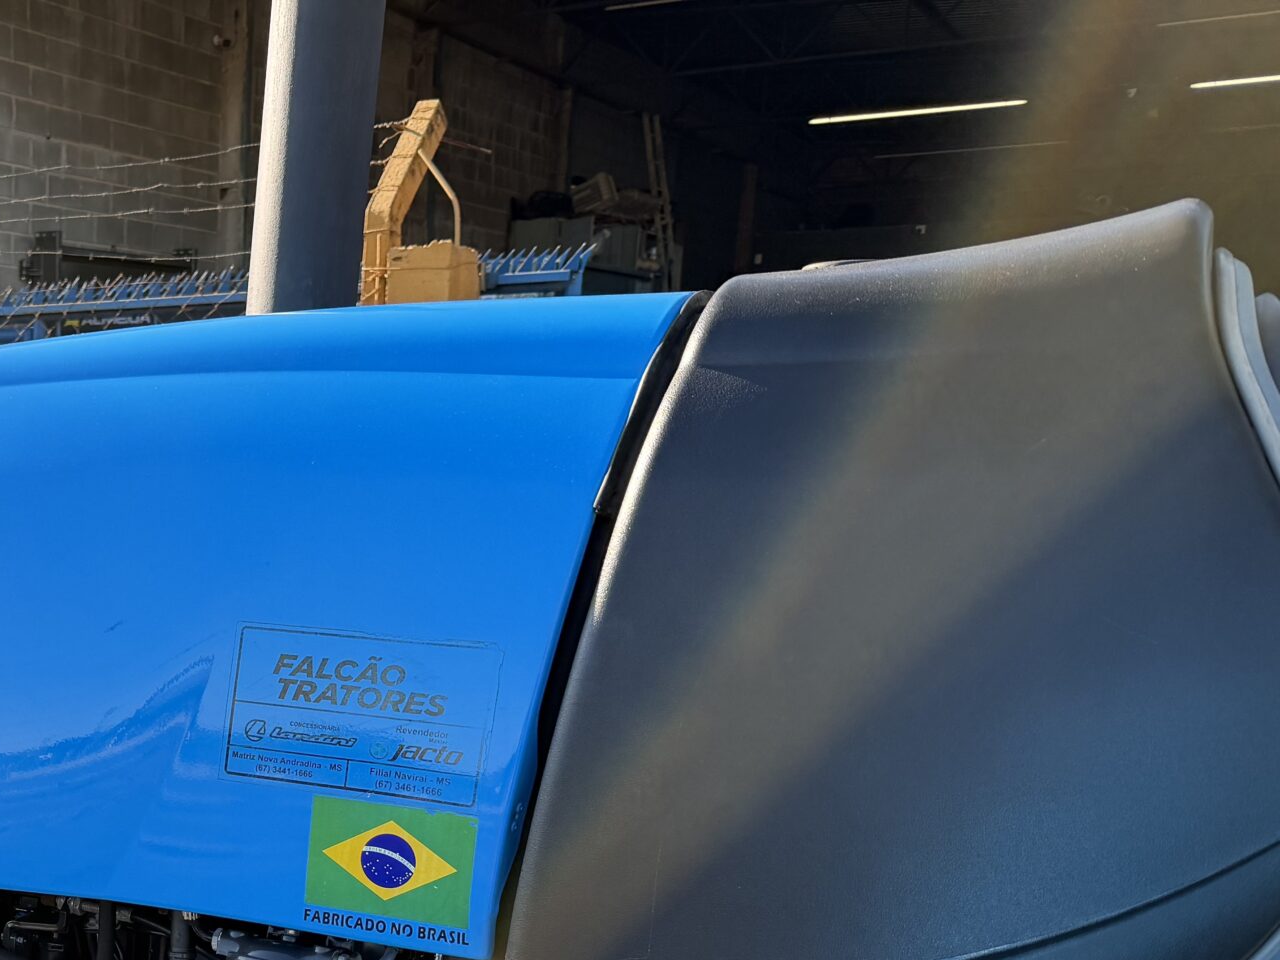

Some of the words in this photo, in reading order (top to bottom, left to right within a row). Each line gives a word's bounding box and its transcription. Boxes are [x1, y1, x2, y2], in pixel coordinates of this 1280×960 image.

[272, 653, 407, 687] FALCÃO
[276, 677, 449, 718] TRATORES
[395, 724, 449, 739] Revendedor
[232, 750, 256, 762] Matriz
[257, 753, 279, 765] Nova
[279, 756, 322, 770] Andradina
[329, 762, 344, 772] MS
[255, 763, 271, 774] (67)
[272, 765, 314, 779] 3441-1666
[369, 767, 392, 779] Filial
[436, 776, 452, 787] MS
[374, 779, 393, 791] (67)
[394, 781, 443, 797] 3461-1666
[303, 908, 387, 934] FABRICADO
[390, 921, 414, 938] NO
[417, 926, 470, 946] BRASIL
